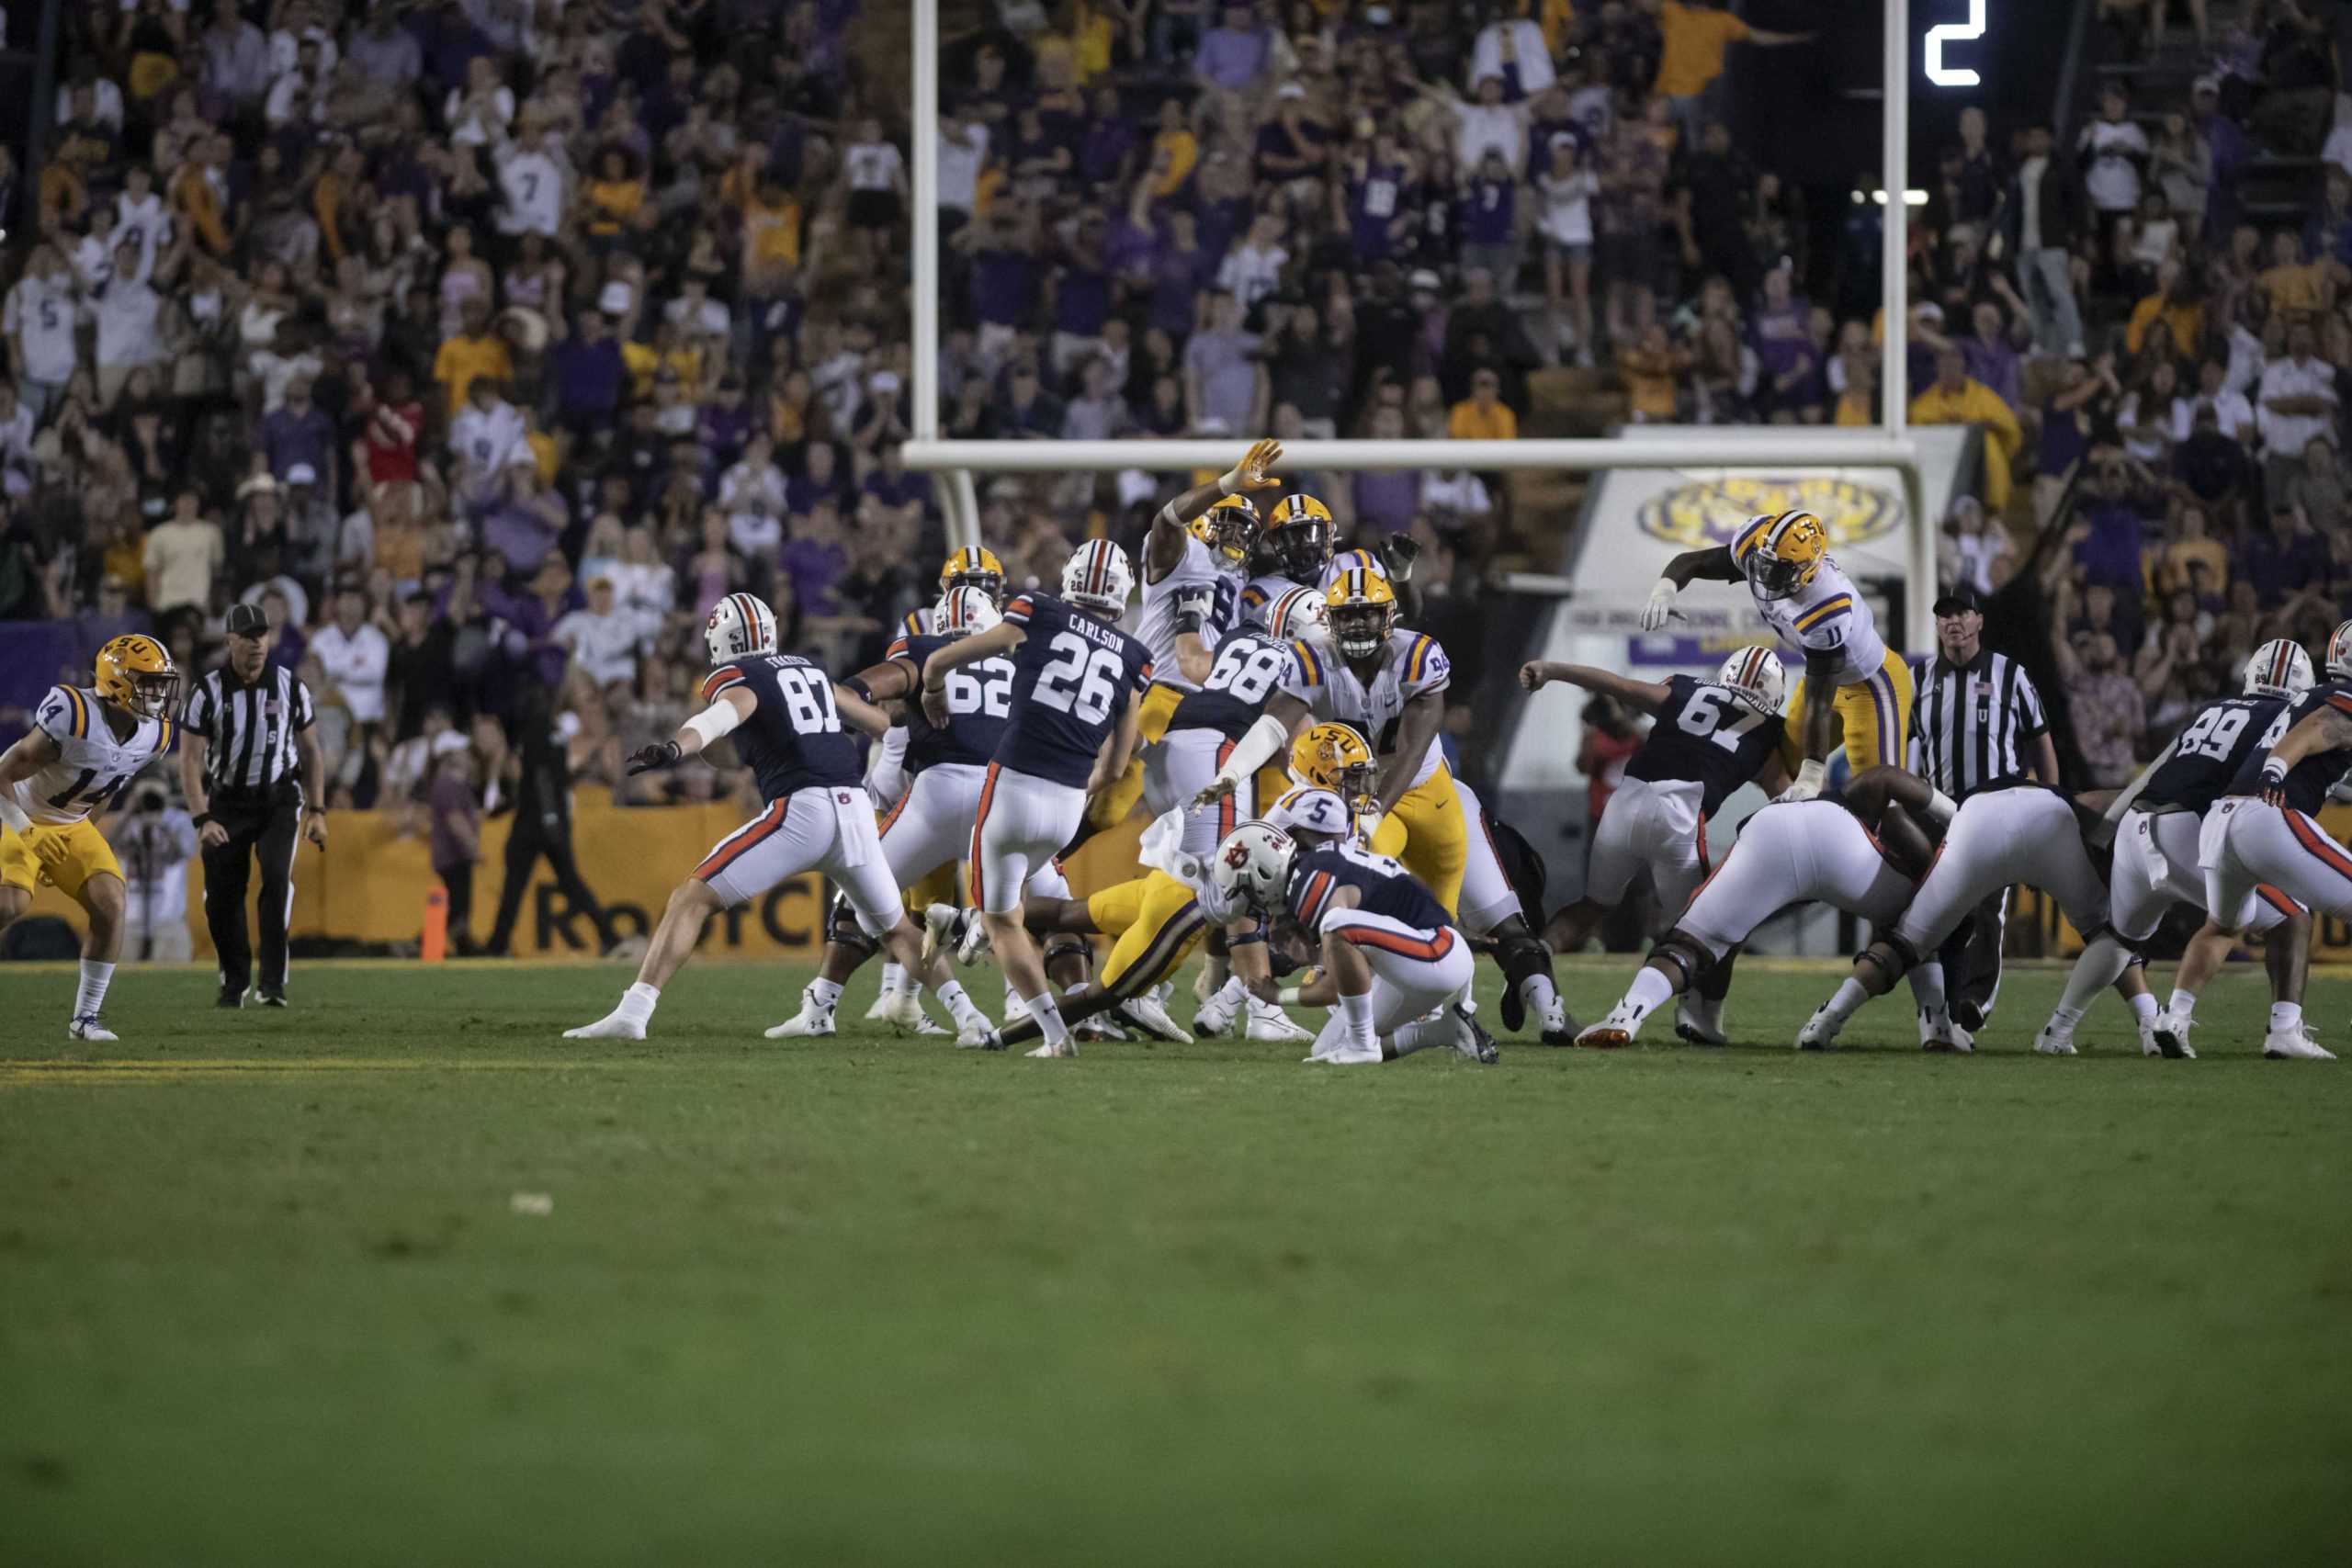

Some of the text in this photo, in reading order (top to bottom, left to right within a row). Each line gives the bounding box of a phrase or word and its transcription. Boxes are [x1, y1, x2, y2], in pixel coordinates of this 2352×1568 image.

[1925, 0, 1985, 86] 2
[519, 172, 540, 202] 7
[40, 298, 58, 329] 5
[1071, 580, 1083, 593] 26
[1069, 614, 1125, 654] CARLSON
[944, 656, 1017, 719] 62
[1031, 631, 1125, 726] 26
[1204, 637, 1283, 705] 68
[2255, 673, 2267, 684] 89
[776, 667, 842, 736] 87
[1978, 709, 1988, 723] U
[267, 730, 277, 744] S
[1677, 685, 1767, 754] 67
[2176, 706, 2250, 762] 89
[1310, 728, 1356, 754] LSU
[1308, 797, 1332, 824] 5
